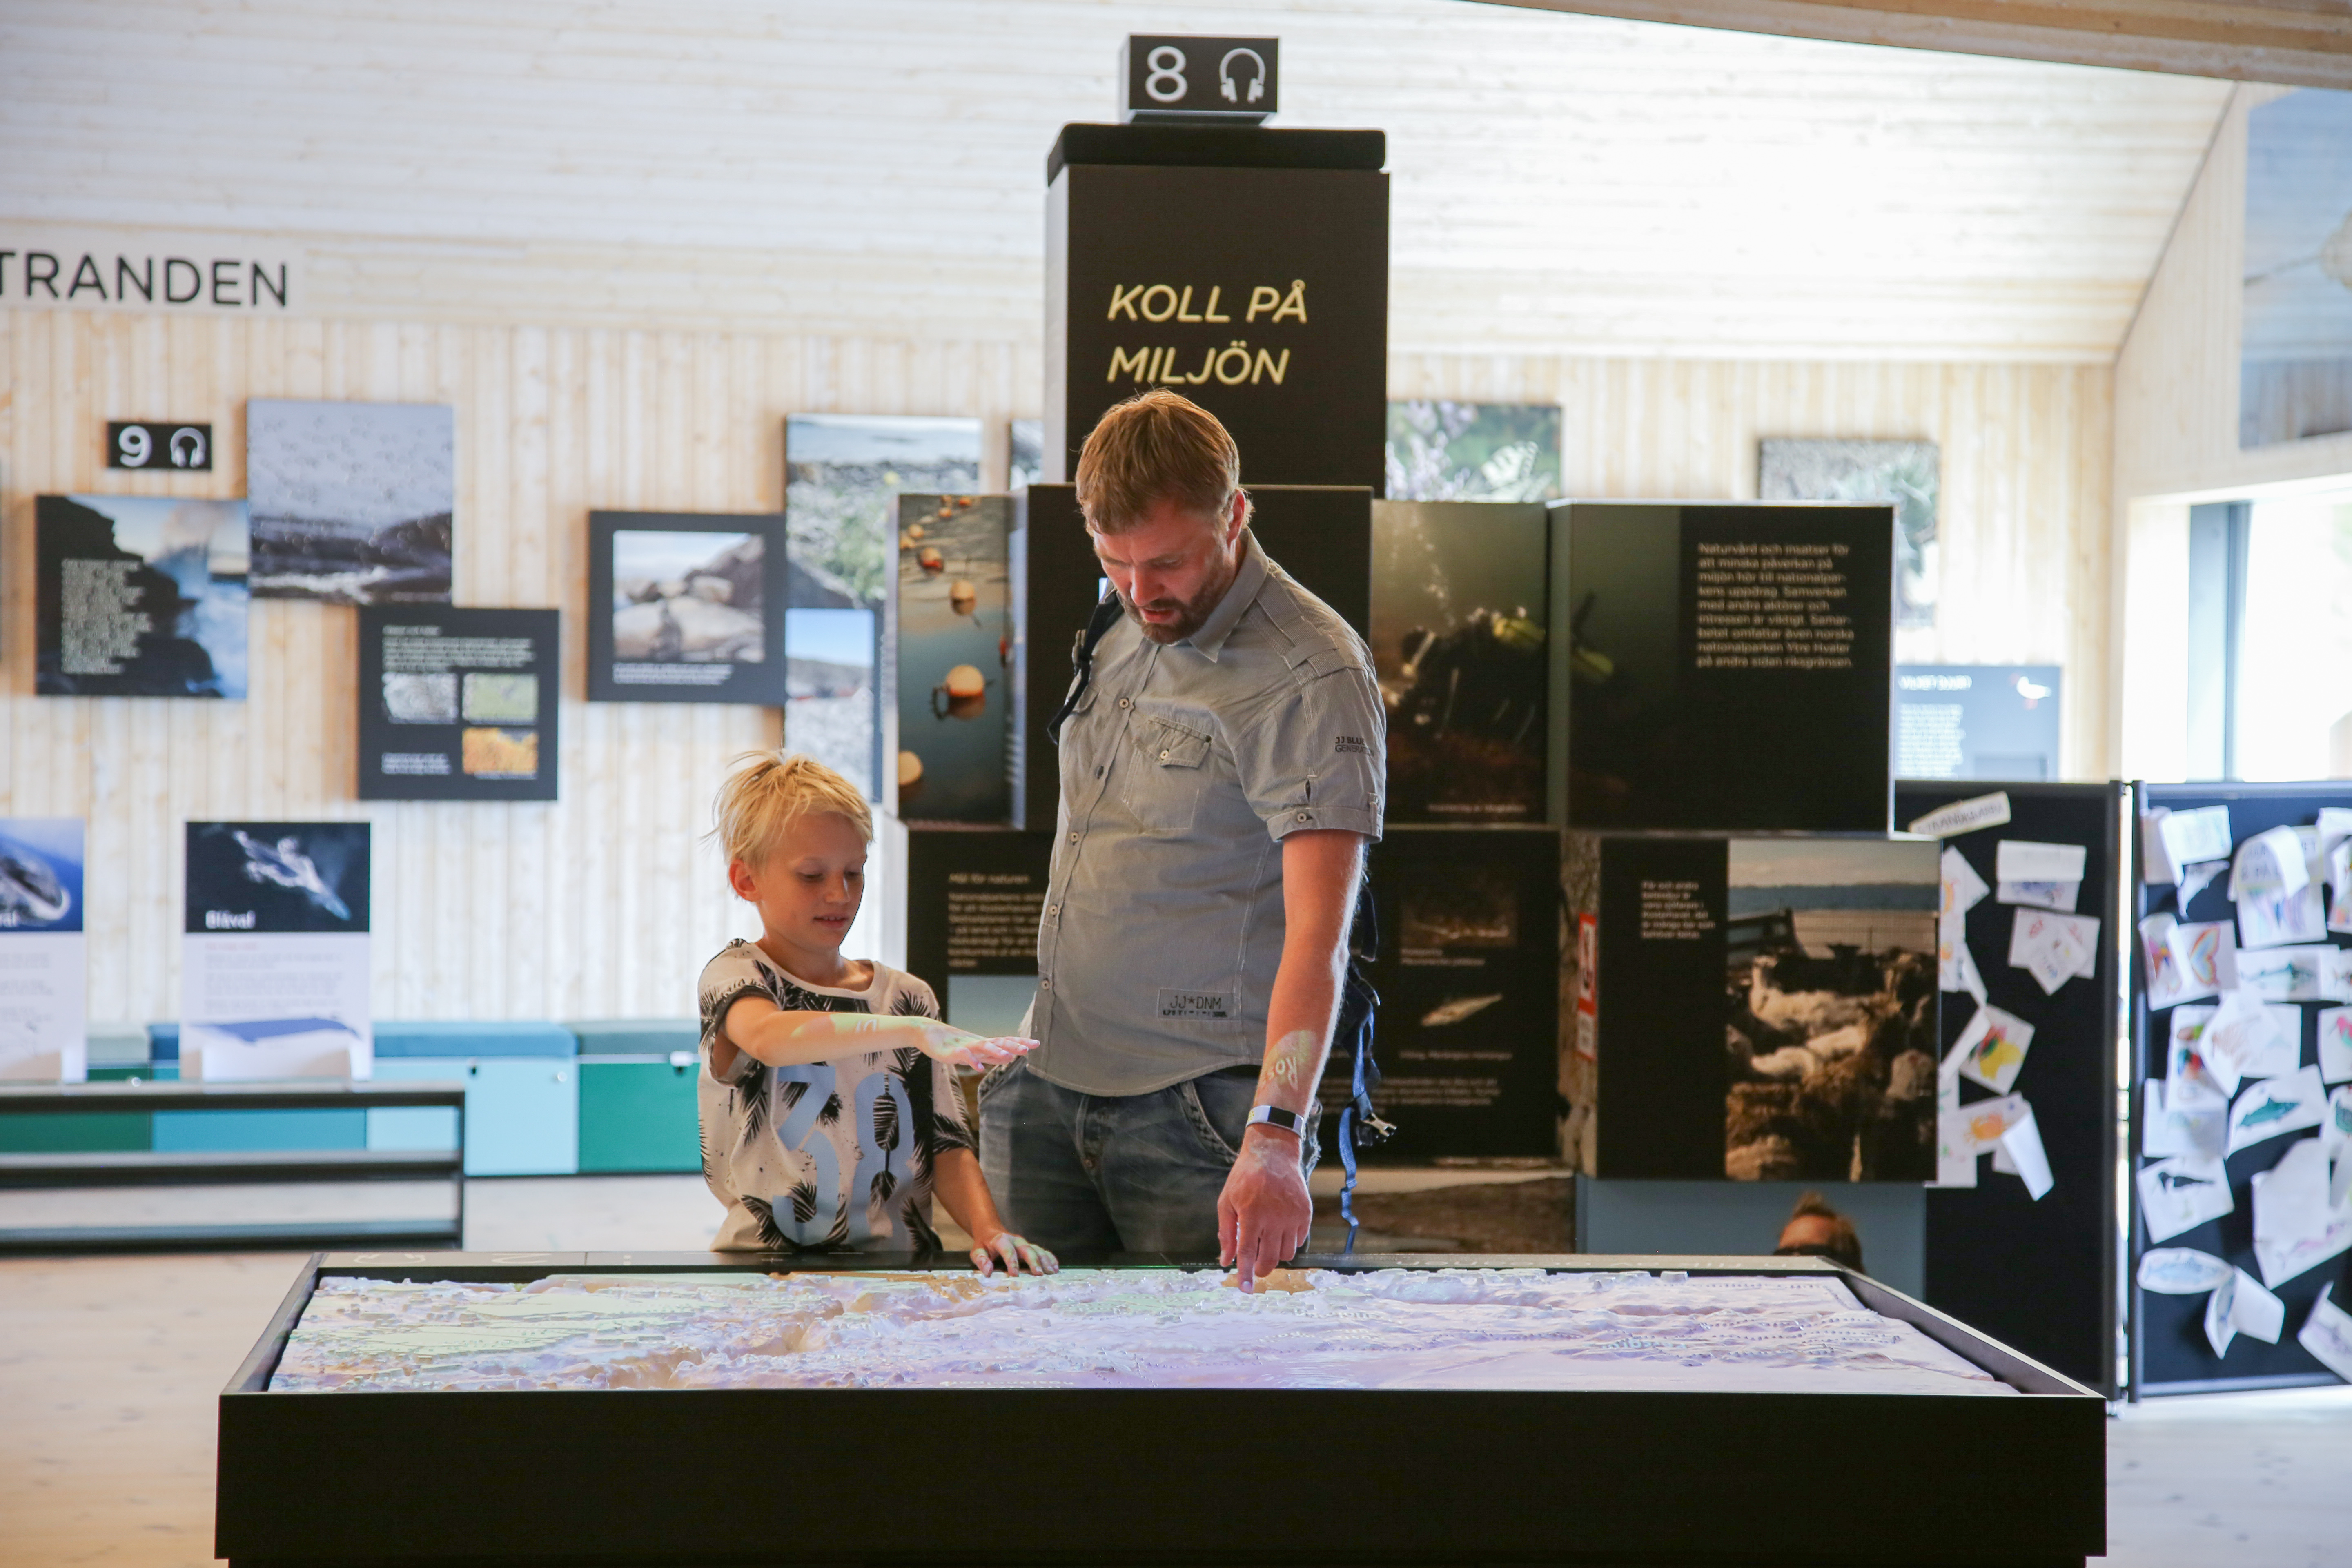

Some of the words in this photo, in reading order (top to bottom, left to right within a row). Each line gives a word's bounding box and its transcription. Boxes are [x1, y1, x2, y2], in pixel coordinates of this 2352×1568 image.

[1145, 46, 1187, 103] 8
[1107, 284, 1230, 323] KOLL
[1246, 279, 1308, 324] PÅ
[1107, 340, 1290, 385] MILJÖN
[119, 425, 152, 467] 9
[205, 909, 256, 929] Blåval
